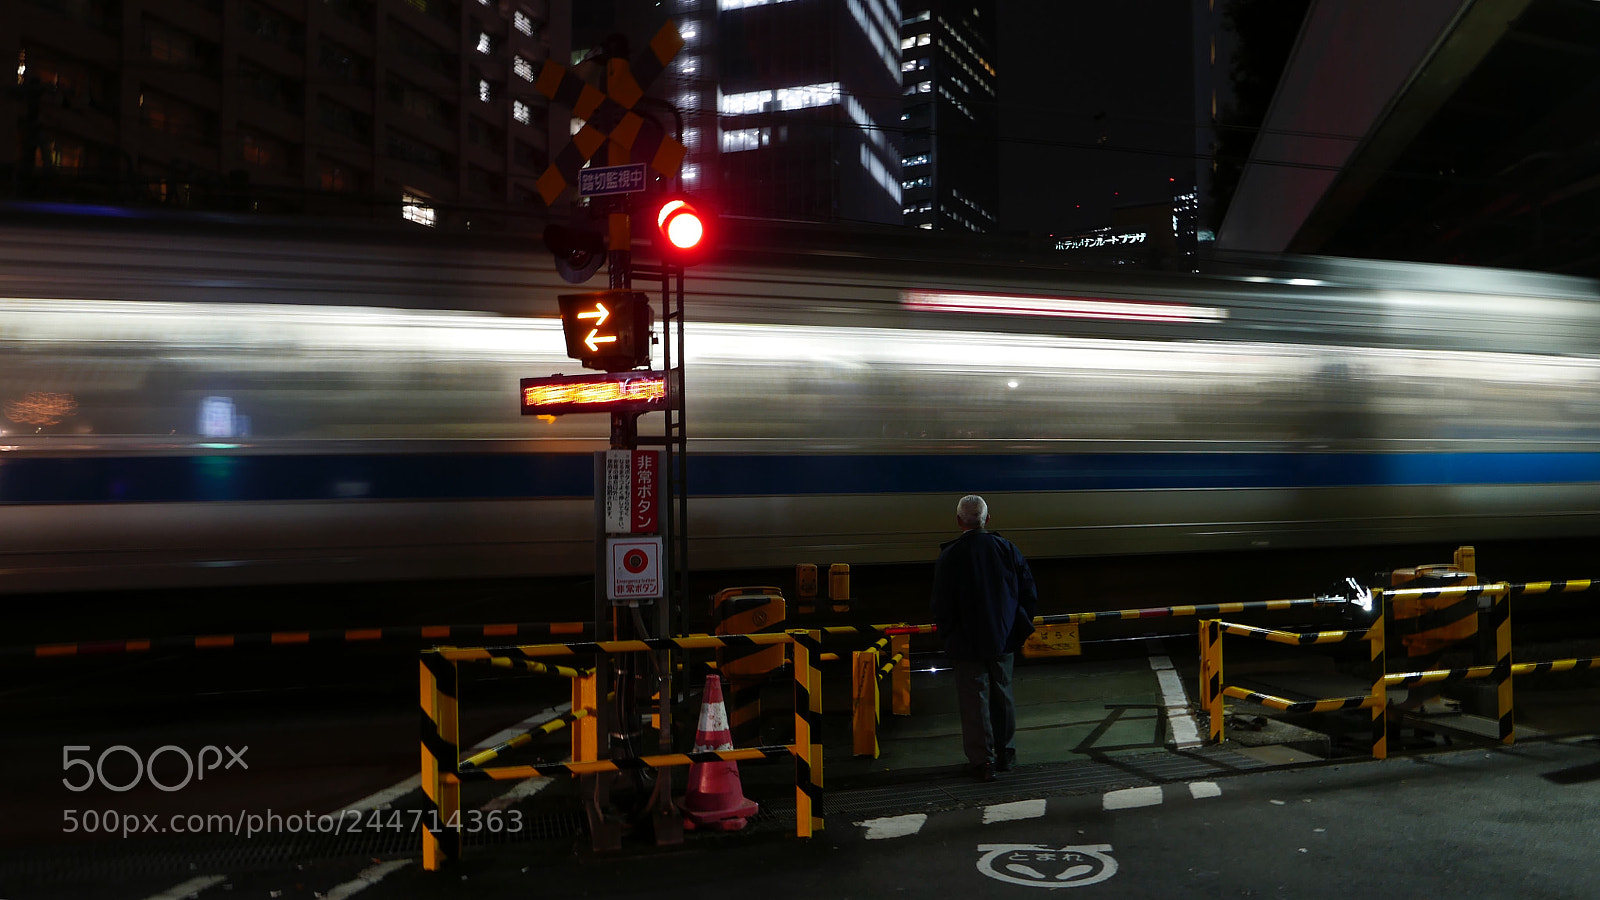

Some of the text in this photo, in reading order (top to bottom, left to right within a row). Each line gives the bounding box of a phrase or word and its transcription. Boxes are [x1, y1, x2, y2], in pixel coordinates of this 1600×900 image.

[582, 168, 643, 192] 踏切監視中
[637, 454, 653, 528] 非常ボタン
[616, 582, 657, 595] 非常ボタン
[1008, 852, 1084, 862] とまれ
